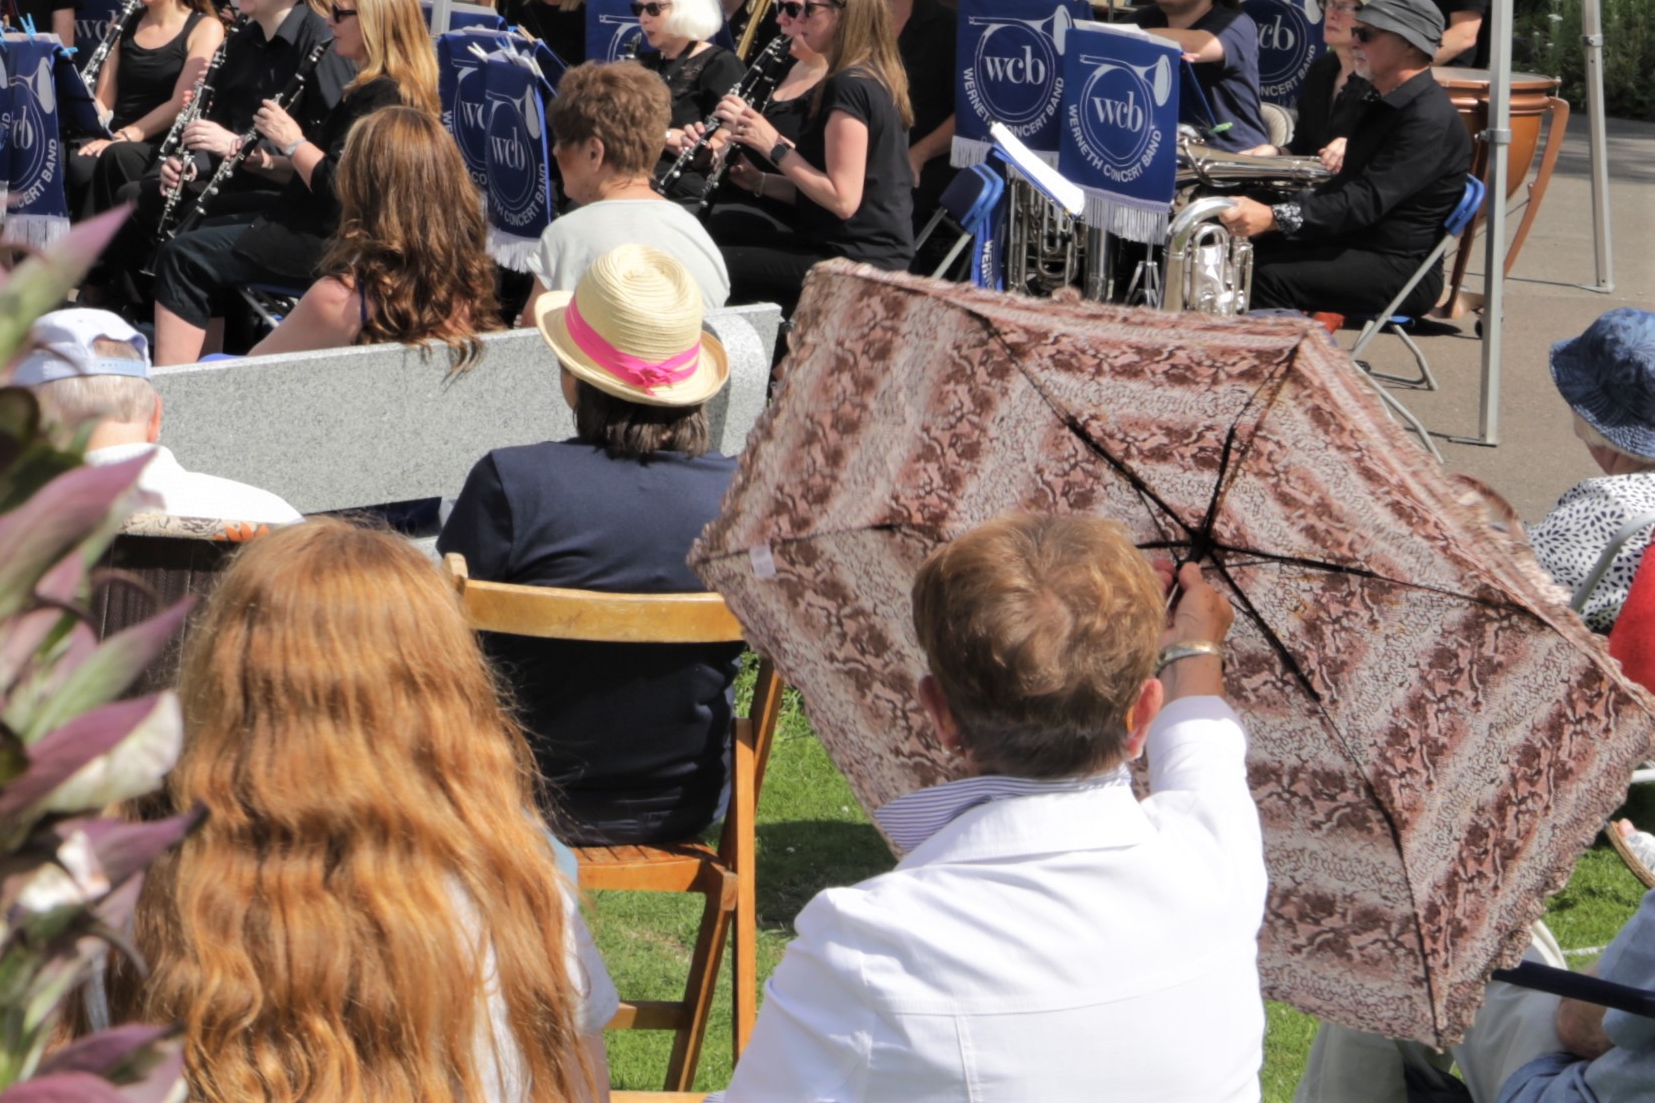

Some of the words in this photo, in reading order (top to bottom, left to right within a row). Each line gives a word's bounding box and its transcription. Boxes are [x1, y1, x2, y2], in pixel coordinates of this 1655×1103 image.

[984, 46, 1045, 85] wcb
[1298, 44, 1316, 80] BAND
[1046, 76, 1064, 116] BAND
[1094, 91, 1143, 133] wcb
[45, 138, 58, 183] BAND
[490, 126, 525, 171] wcb
[1068, 103, 1103, 170] WERNETH
[1103, 163, 1143, 182] CONCERT
[1142, 129, 1162, 168] BAND
